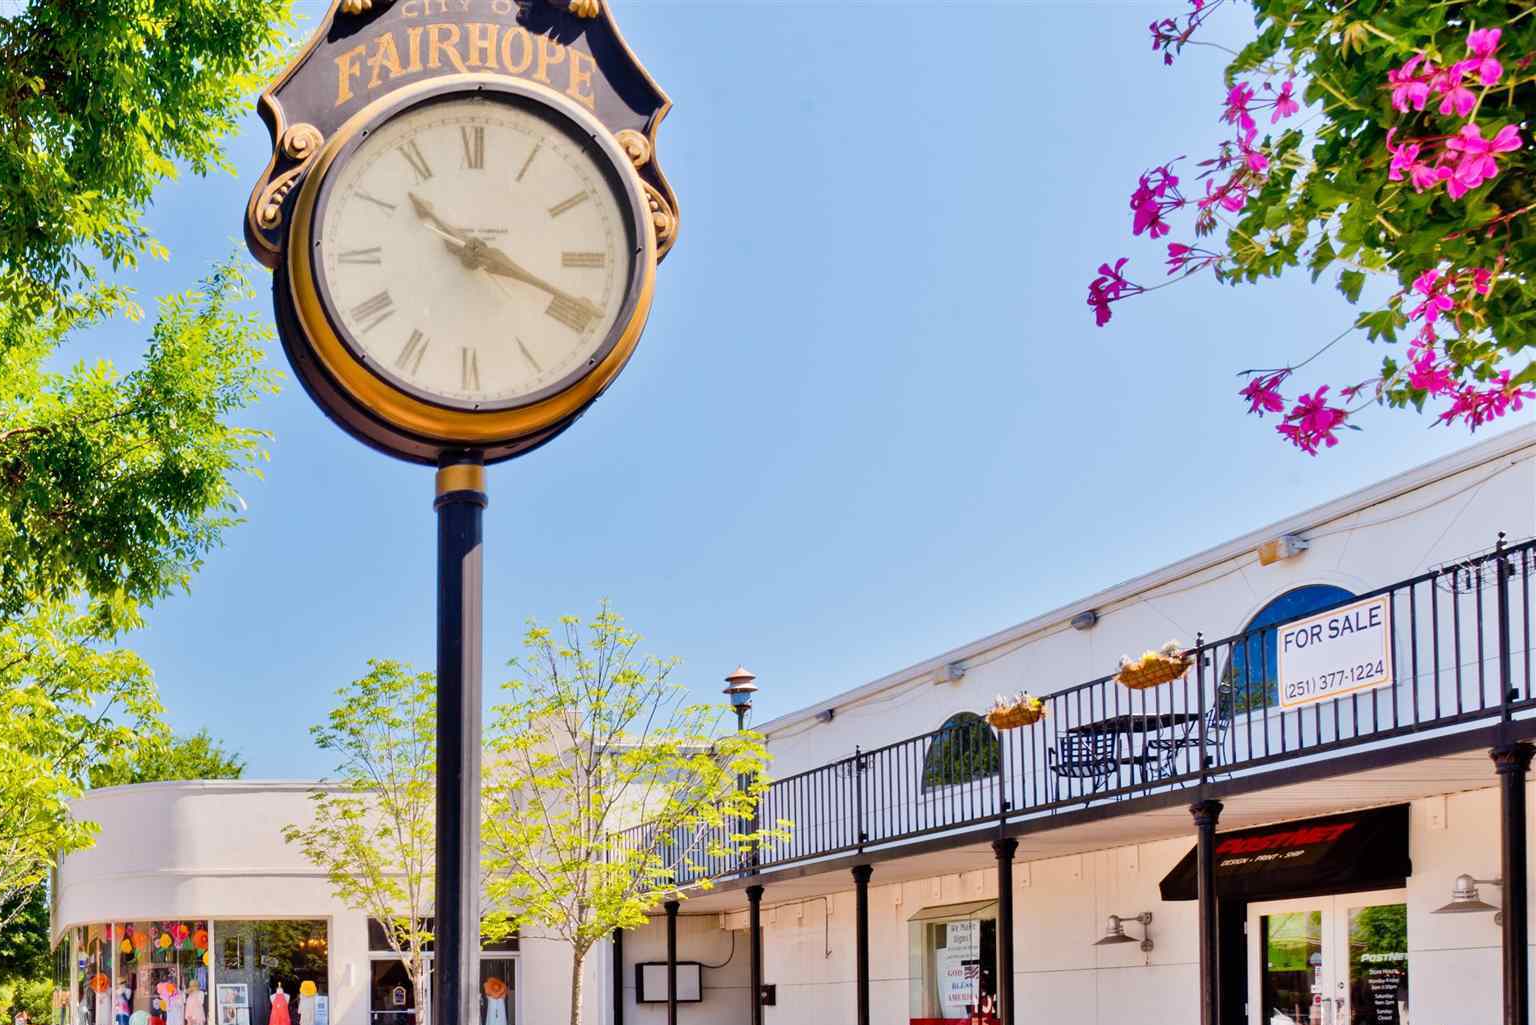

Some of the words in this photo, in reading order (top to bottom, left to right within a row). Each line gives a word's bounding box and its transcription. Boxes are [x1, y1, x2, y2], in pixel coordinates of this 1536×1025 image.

[334, 22, 596, 110] FAIRHOPE
[1284, 624, 1322, 652] FOR
[1328, 605, 1382, 639] SALE
[1285, 677, 1316, 699] (251)
[1319, 659, 1384, 690] 377-1224
